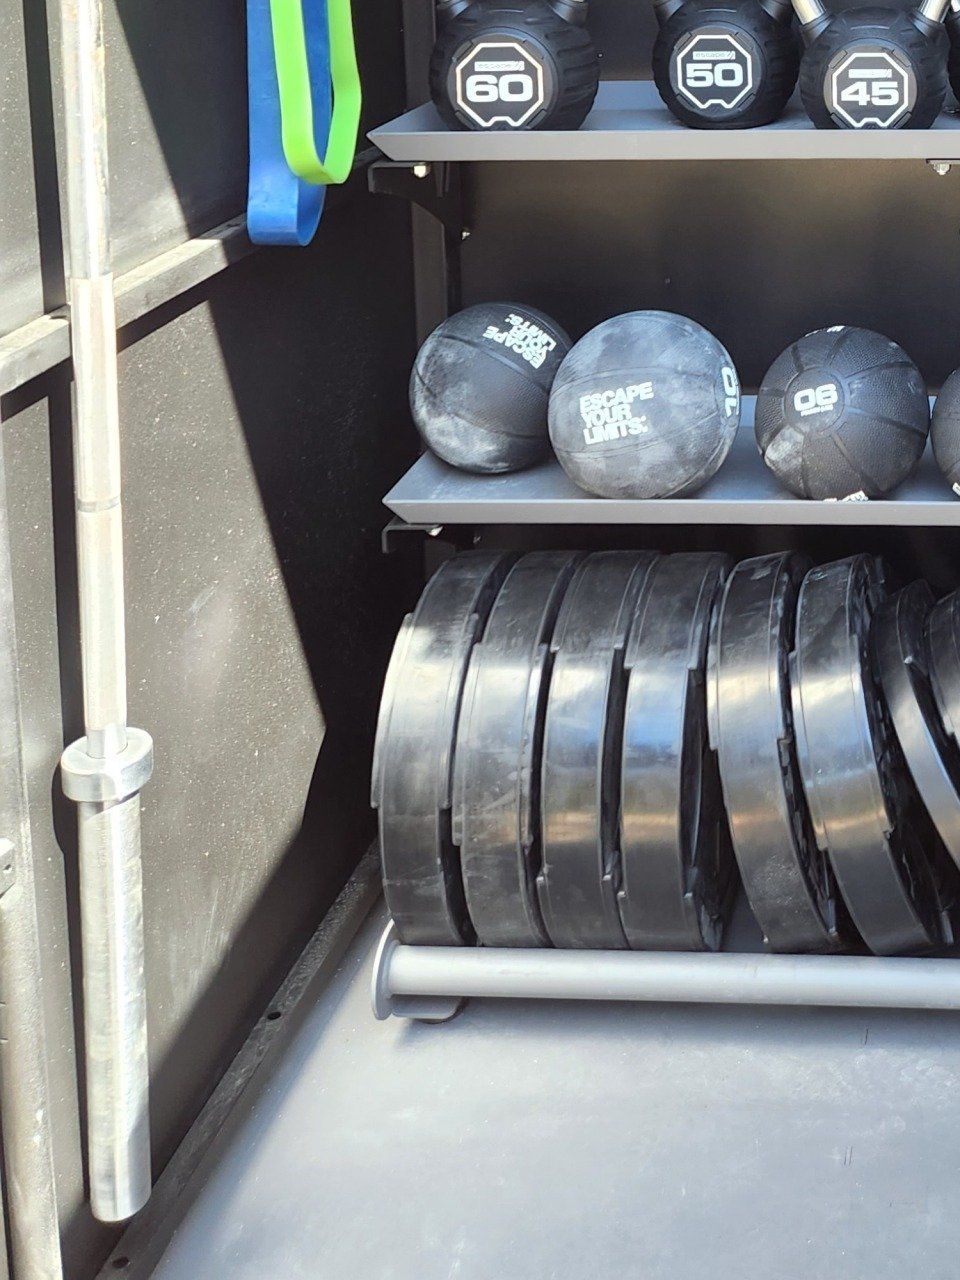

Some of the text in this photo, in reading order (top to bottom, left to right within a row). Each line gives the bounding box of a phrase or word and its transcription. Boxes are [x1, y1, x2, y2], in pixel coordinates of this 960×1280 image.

[465, 73, 533, 103] 60
[685, 62, 744, 87] 50
[840, 81, 899, 106] 45
[579, 381, 654, 414] ESCAPE
[793, 383, 838, 412] 06
[580, 403, 632, 429] YOUR
